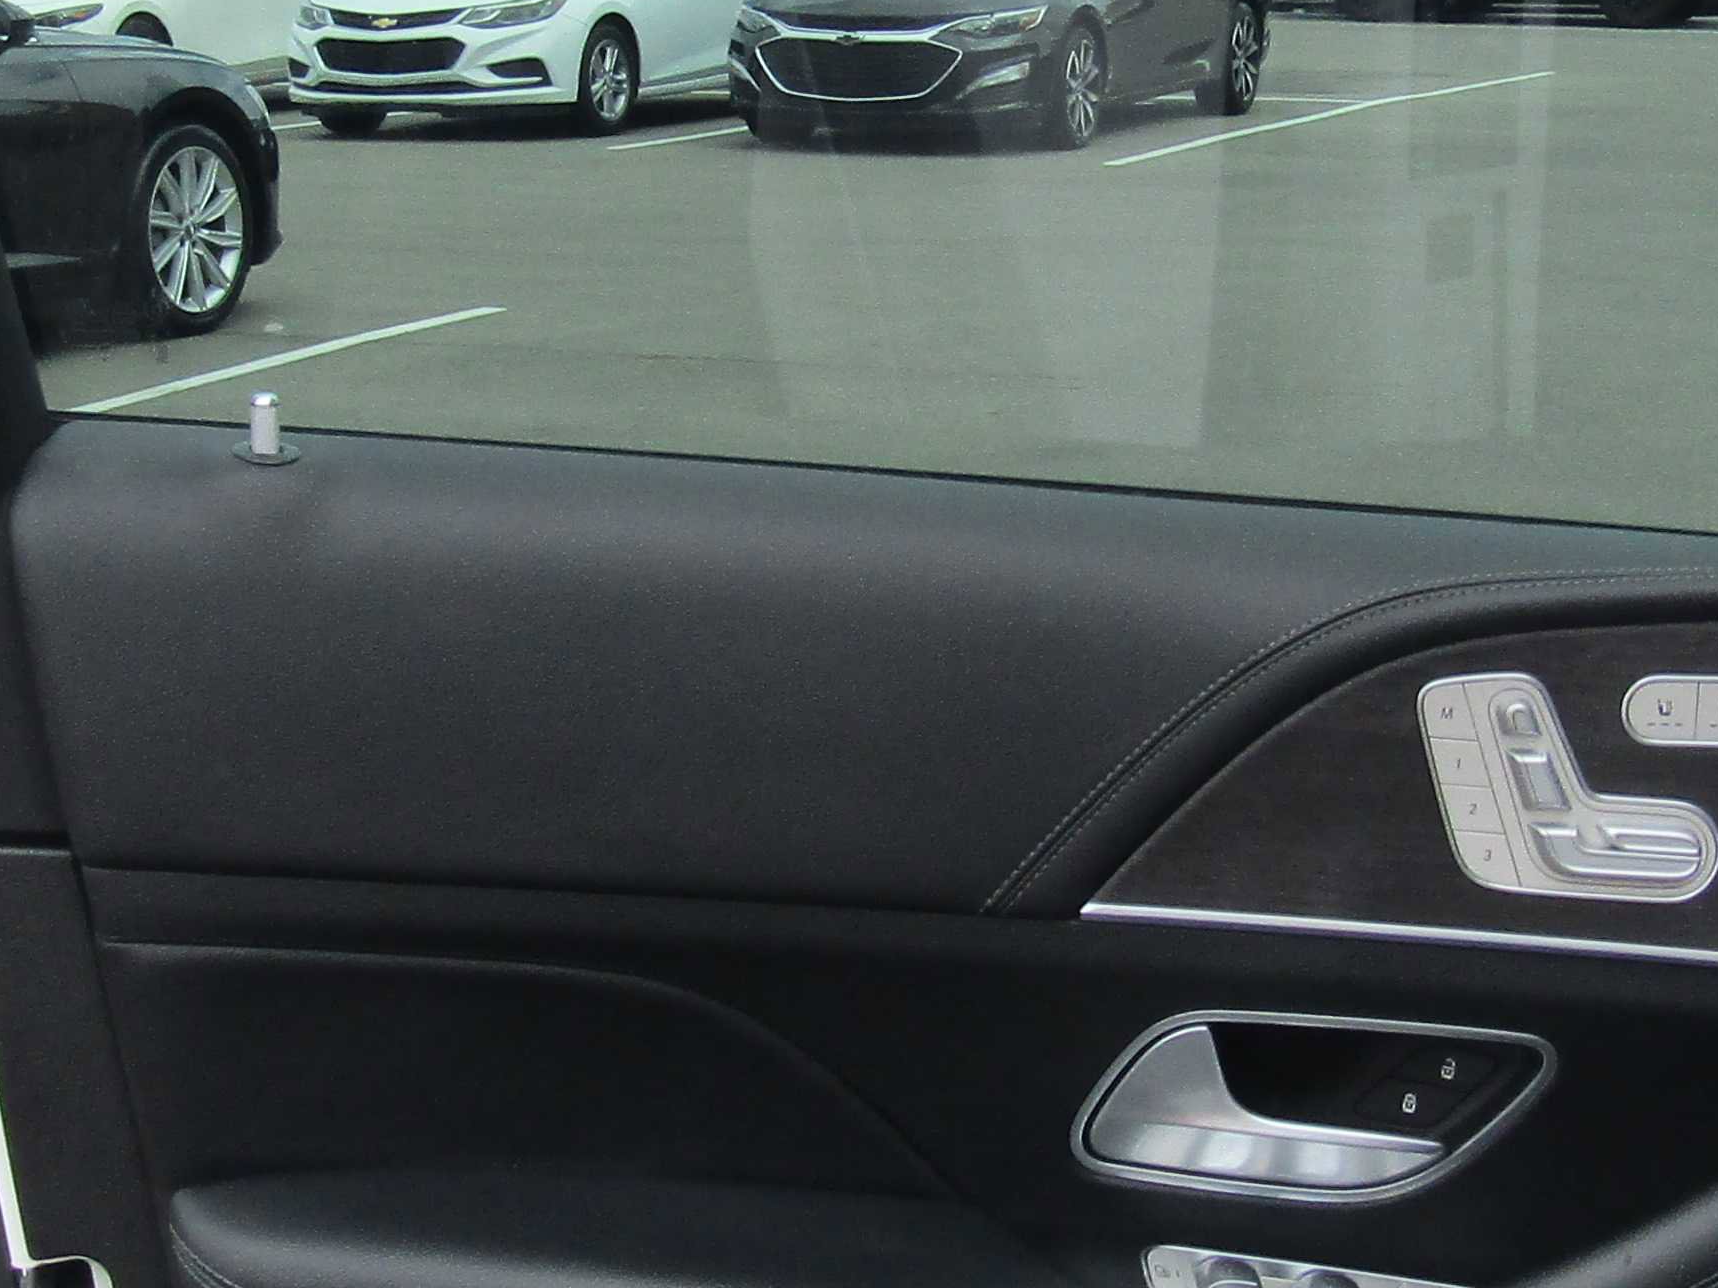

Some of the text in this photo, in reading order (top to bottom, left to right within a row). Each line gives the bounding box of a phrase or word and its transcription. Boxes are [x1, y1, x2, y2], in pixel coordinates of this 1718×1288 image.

[1440, 707, 1454, 720] M
[1468, 803, 1477, 816] 2
[1483, 849, 1492, 862] 3
